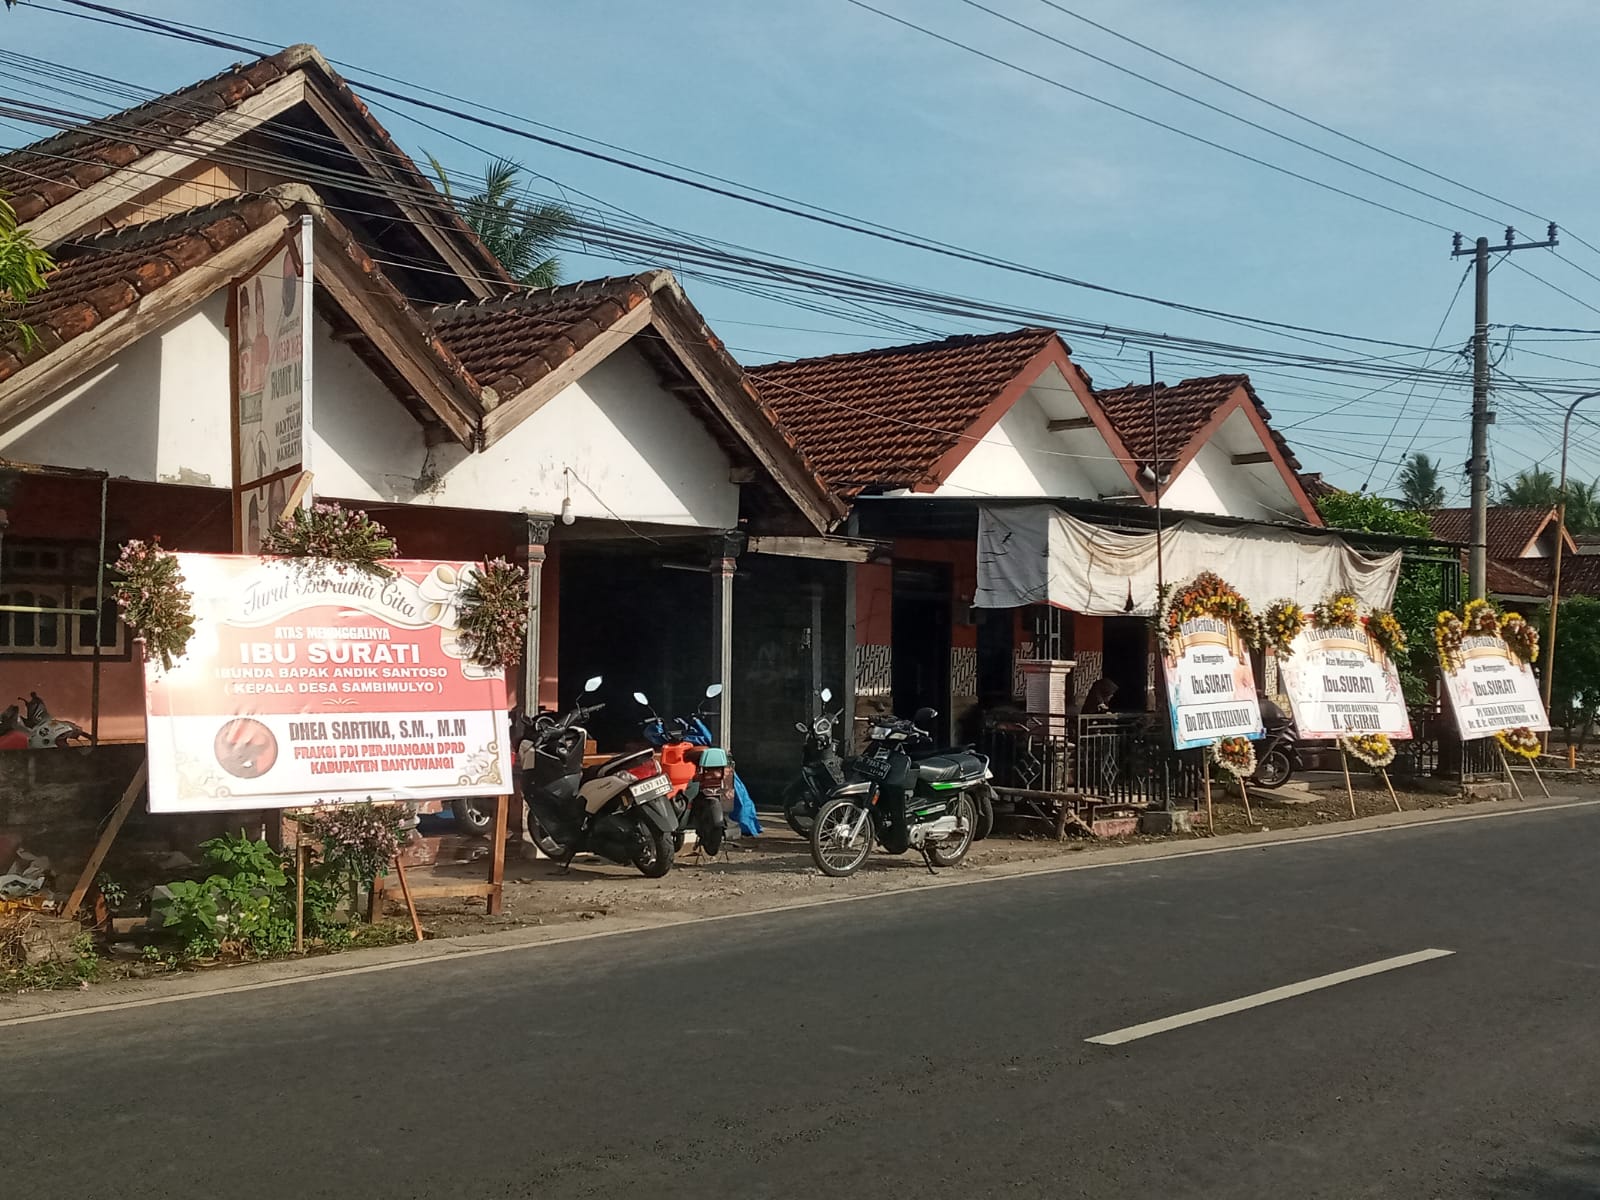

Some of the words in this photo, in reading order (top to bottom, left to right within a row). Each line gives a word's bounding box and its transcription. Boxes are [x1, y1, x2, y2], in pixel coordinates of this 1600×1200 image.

[380, 583, 418, 618] Cita
[274, 626, 304, 640] ATAS
[239, 642, 297, 664] IBU
[308, 642, 420, 664] SURATI
[279, 667, 328, 678] BAPAK
[333, 667, 378, 678] ANDIK
[382, 667, 448, 678] SANTOSO
[235, 682, 294, 694] KEPALA
[299, 682, 338, 694] DESA
[342, 681, 435, 693] SAMBIMULYO
[288, 722, 328, 741] DHEA
[332, 720, 396, 741] SARTIKA,
[399, 719, 434, 739] S.M.,
[437, 718, 467, 737] M.M
[294, 745, 337, 759] FRAKSI
[340, 744, 359, 758] PDI
[361, 742, 435, 757] PERJUANGAN
[437, 741, 466, 755] DPRD
[311, 759, 379, 774] KABUPATEN
[381, 757, 455, 773] BANYUWANGI
